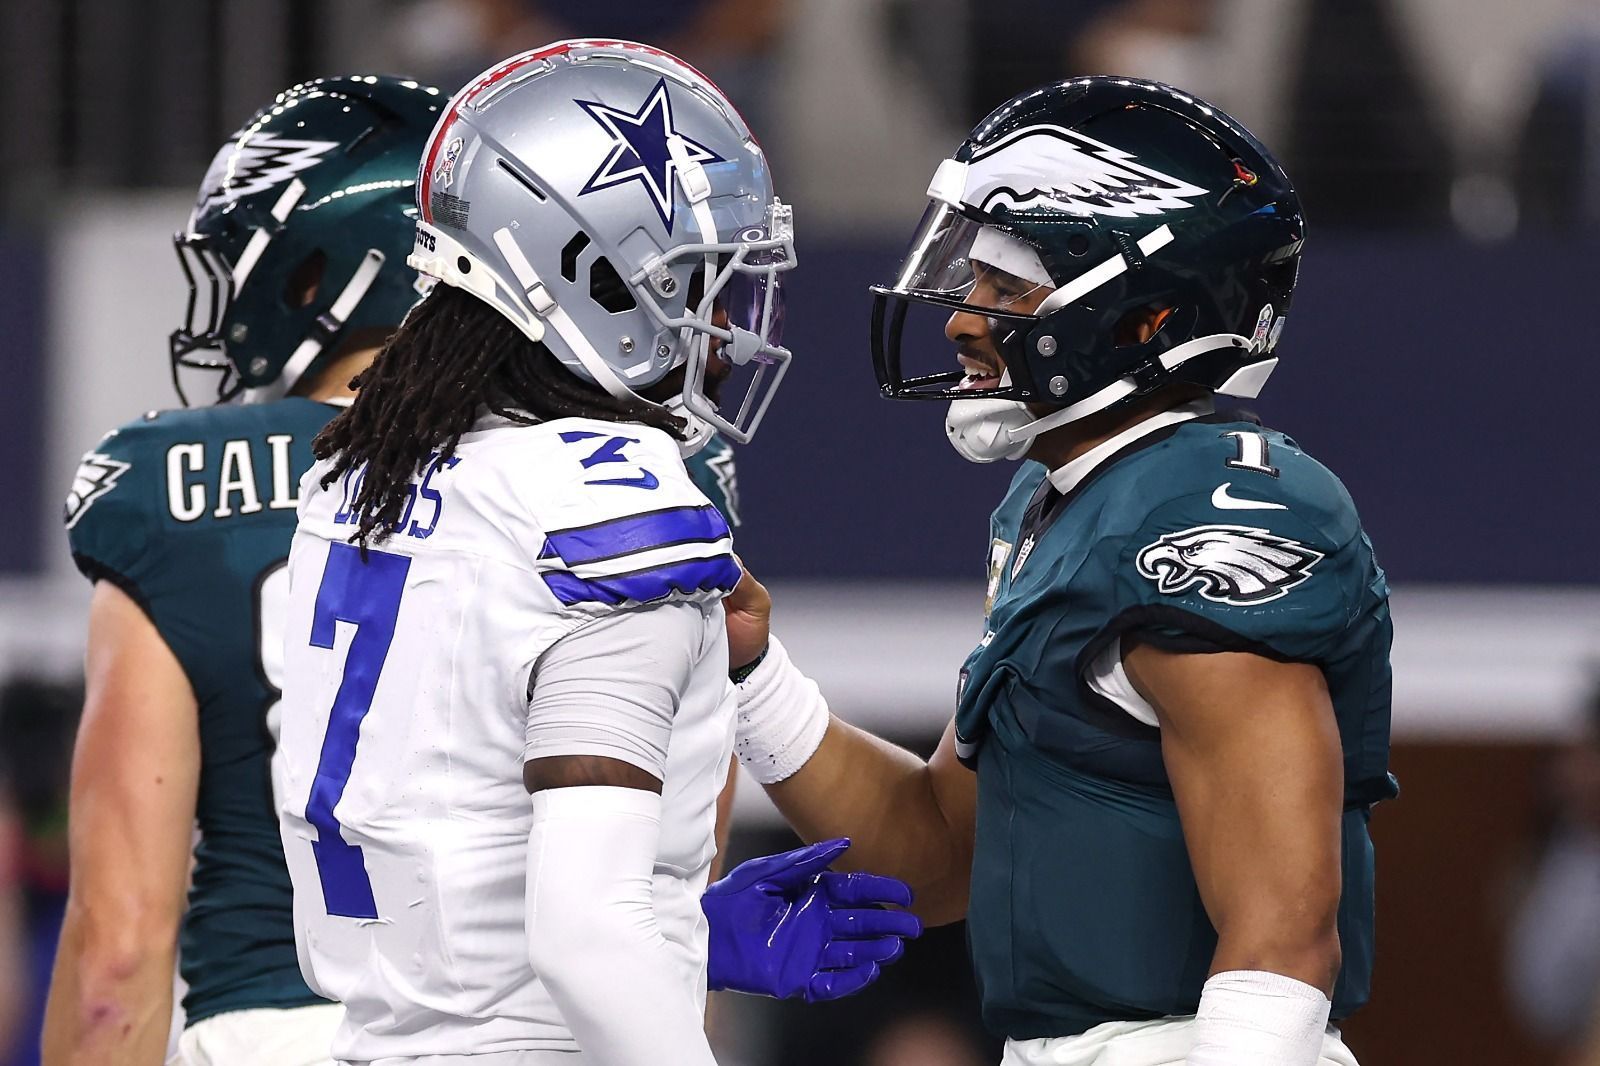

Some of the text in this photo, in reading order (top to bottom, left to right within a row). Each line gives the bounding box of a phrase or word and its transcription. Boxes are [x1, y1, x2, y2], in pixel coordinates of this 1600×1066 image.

[557, 431, 640, 469] 7
[1219, 431, 1280, 479] 1
[305, 541, 412, 919] 7
